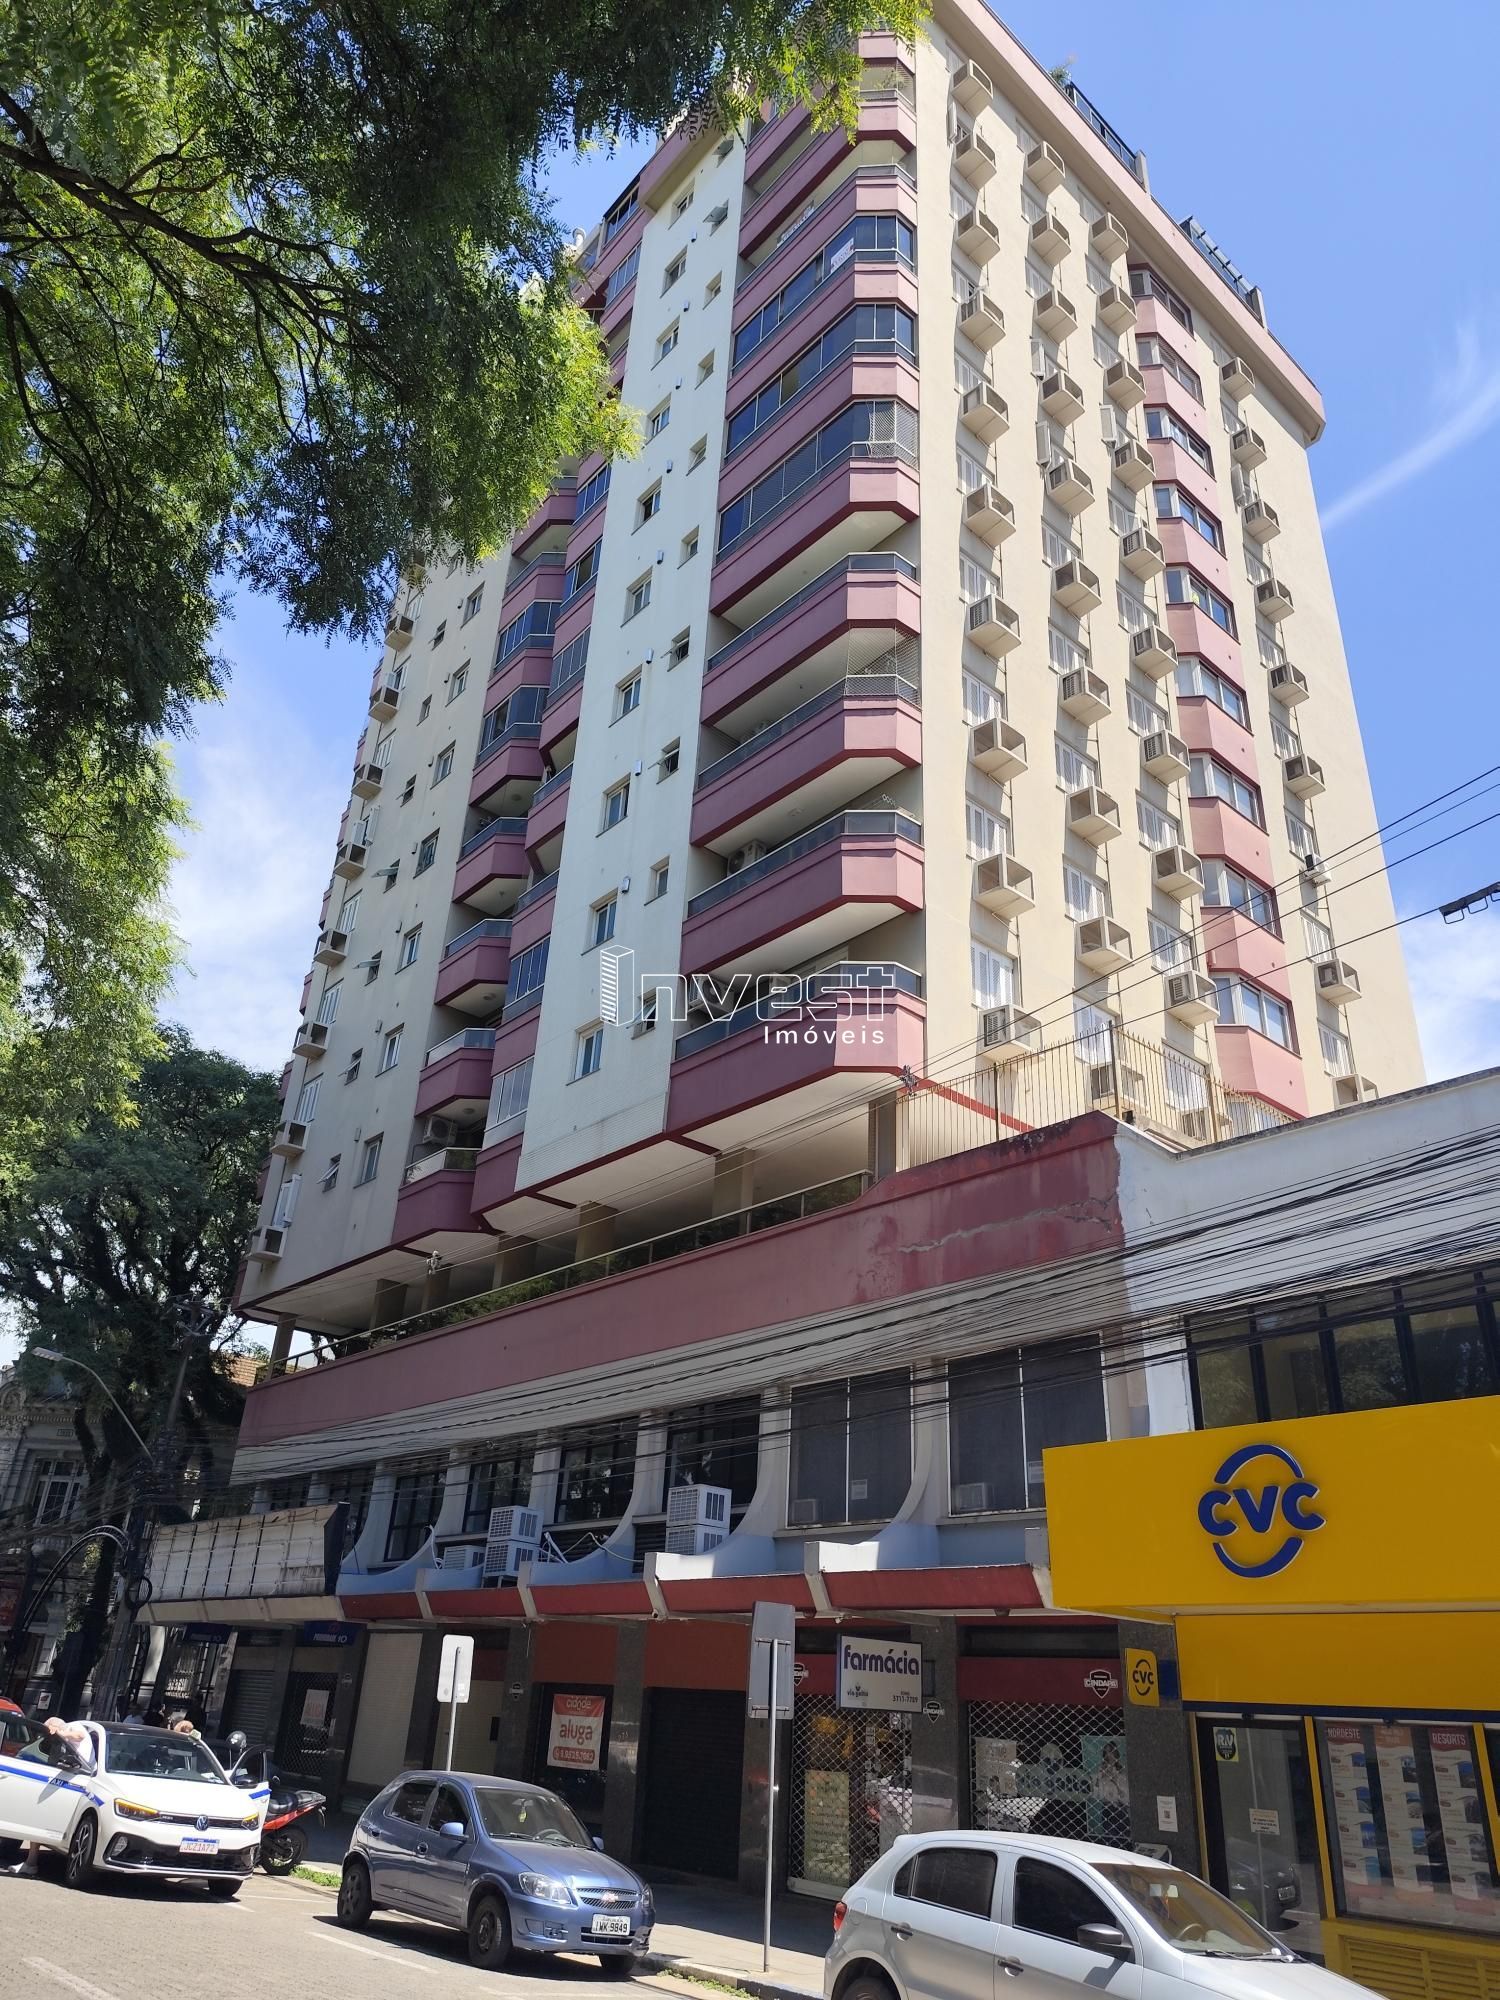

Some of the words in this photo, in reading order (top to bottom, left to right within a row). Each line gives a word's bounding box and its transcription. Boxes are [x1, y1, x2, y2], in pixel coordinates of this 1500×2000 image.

[1197, 1482, 1326, 1537] CVC
[843, 1644, 920, 1675] farmácia
[1132, 1669, 1155, 1685] CVC
[559, 1718, 593, 1746] aluga
[1327, 1727, 1361, 1740] NORDESTE
[1432, 1733, 1466, 1746] RESORTS
